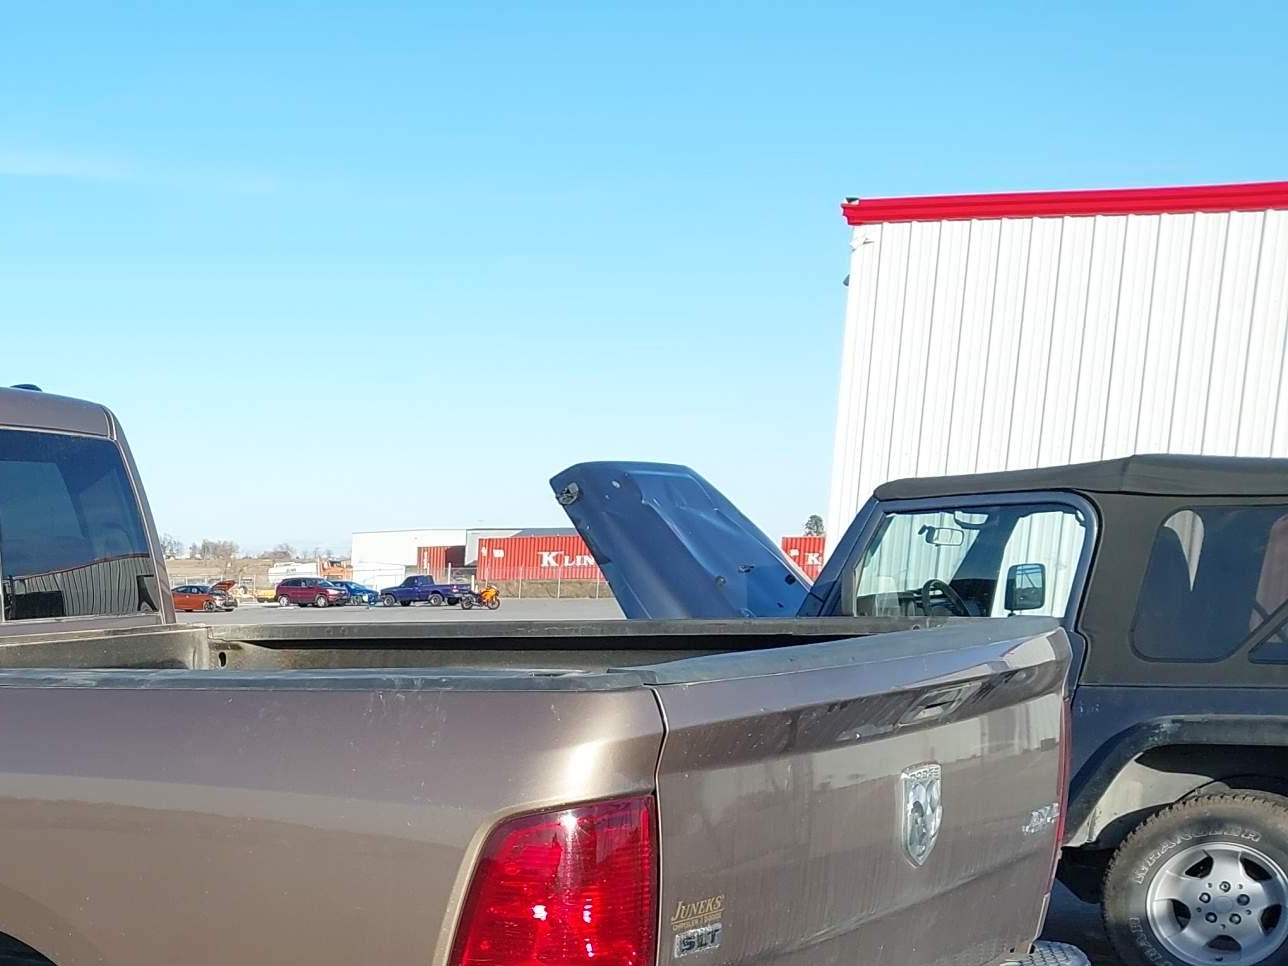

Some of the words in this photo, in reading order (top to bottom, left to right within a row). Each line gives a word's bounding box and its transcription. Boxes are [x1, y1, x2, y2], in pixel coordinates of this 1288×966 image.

[537, 550, 564, 567] K
[564, 554, 596, 567] LIN
[680, 928, 721, 953] SLT
